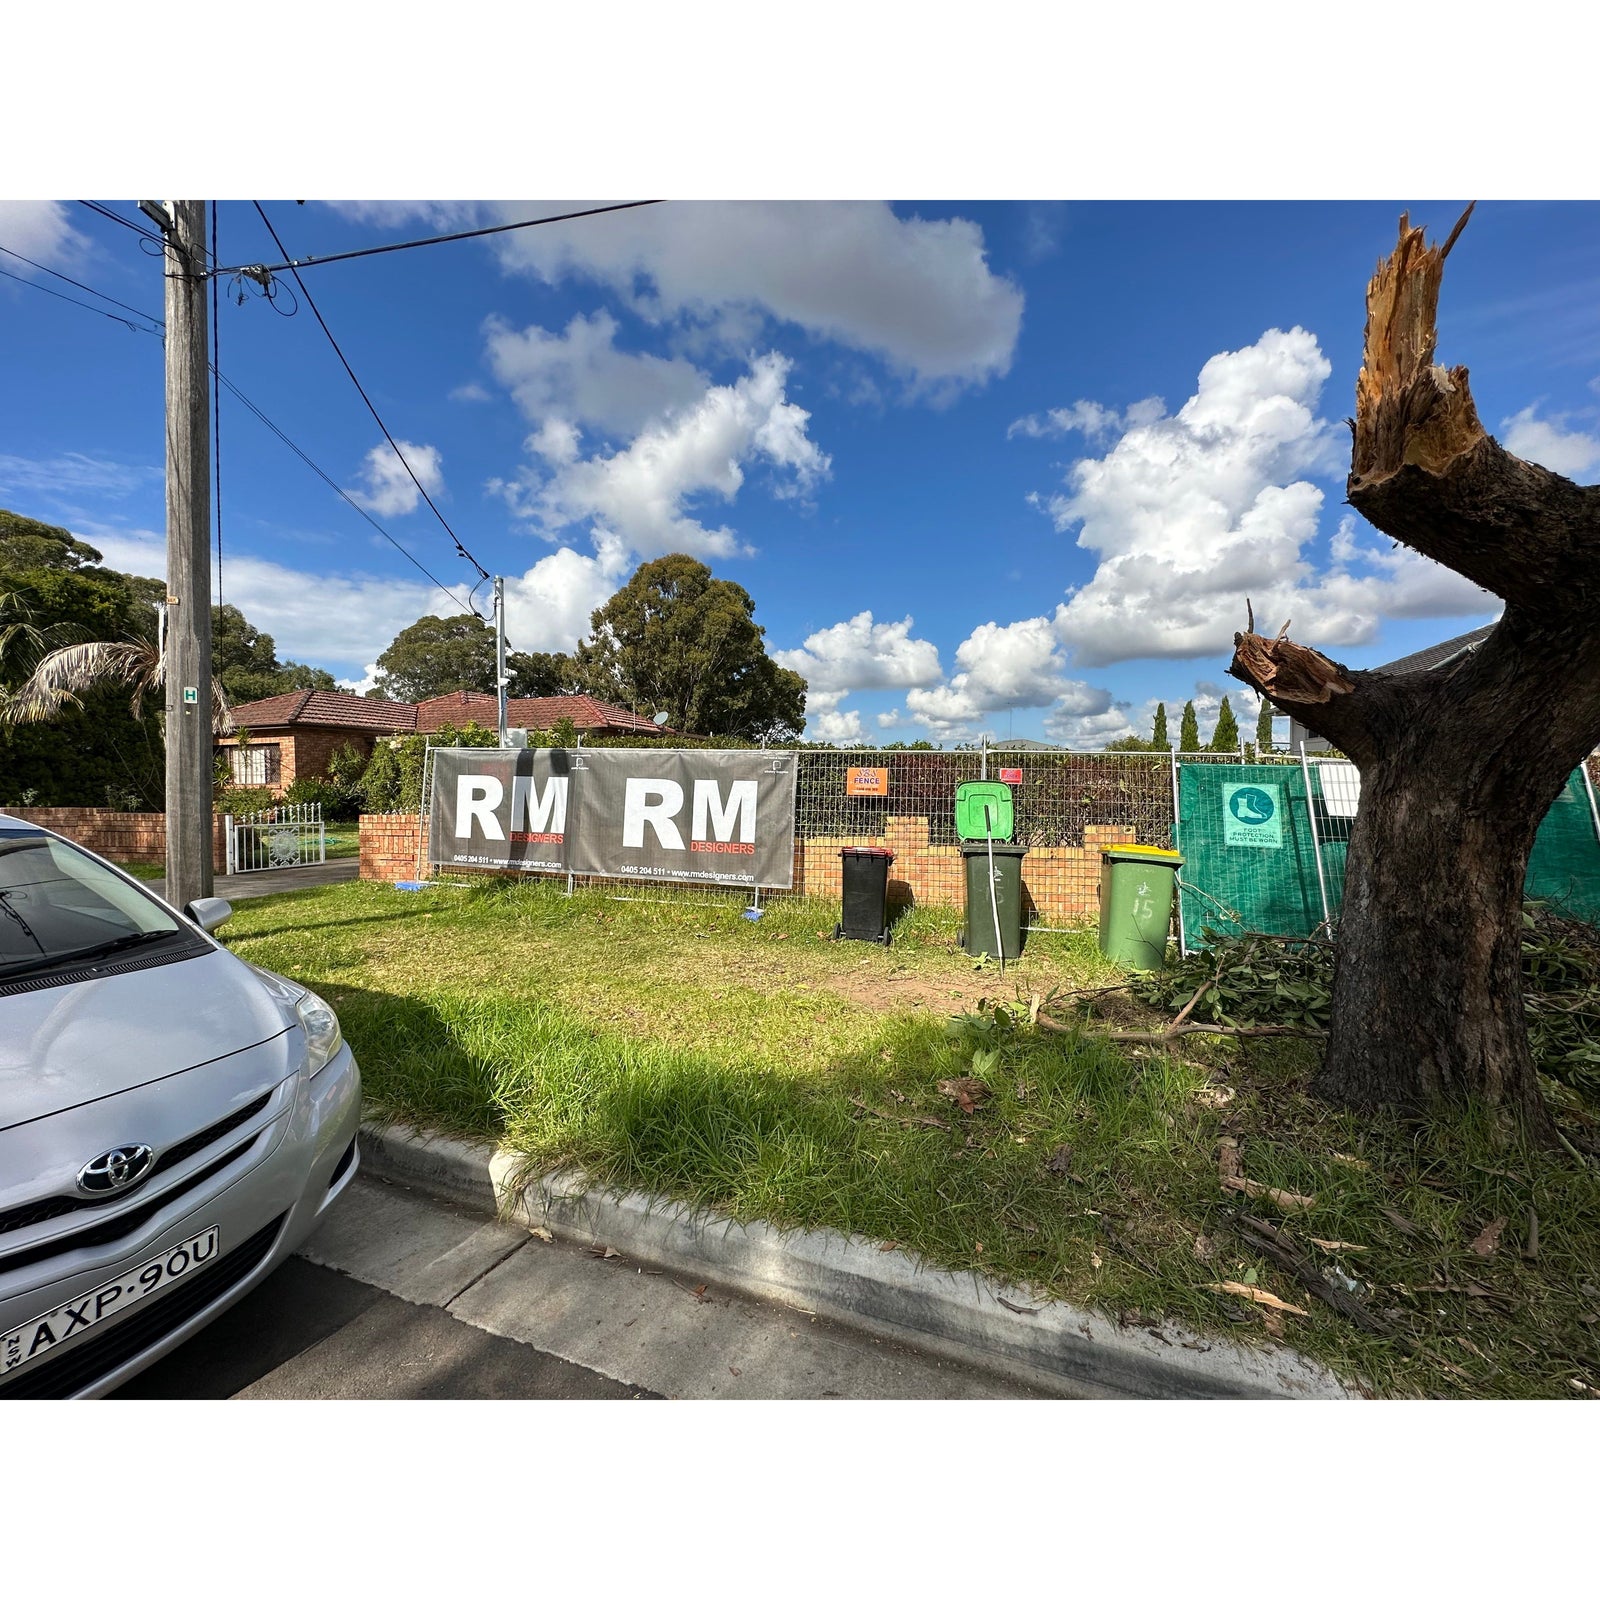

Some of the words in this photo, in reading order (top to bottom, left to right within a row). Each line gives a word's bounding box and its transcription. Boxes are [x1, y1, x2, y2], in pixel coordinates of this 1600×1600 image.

[185, 690, 196, 701] H
[854, 777, 880, 785] FENCE
[455, 774, 569, 841] RM
[622, 777, 759, 850] RM
[510, 831, 564, 844] DESIGNERS
[690, 841, 755, 855] DESIGNERS
[478, 856, 489, 864] 511
[621, 865, 638, 874] 0405
[638, 867, 652, 875] 204
[653, 868, 666, 876] 511
[671, 869, 755, 882] www.rmdesigners.com
[1132, 897, 1155, 919] 15
[5, 1335, 21, 1368] NSW
